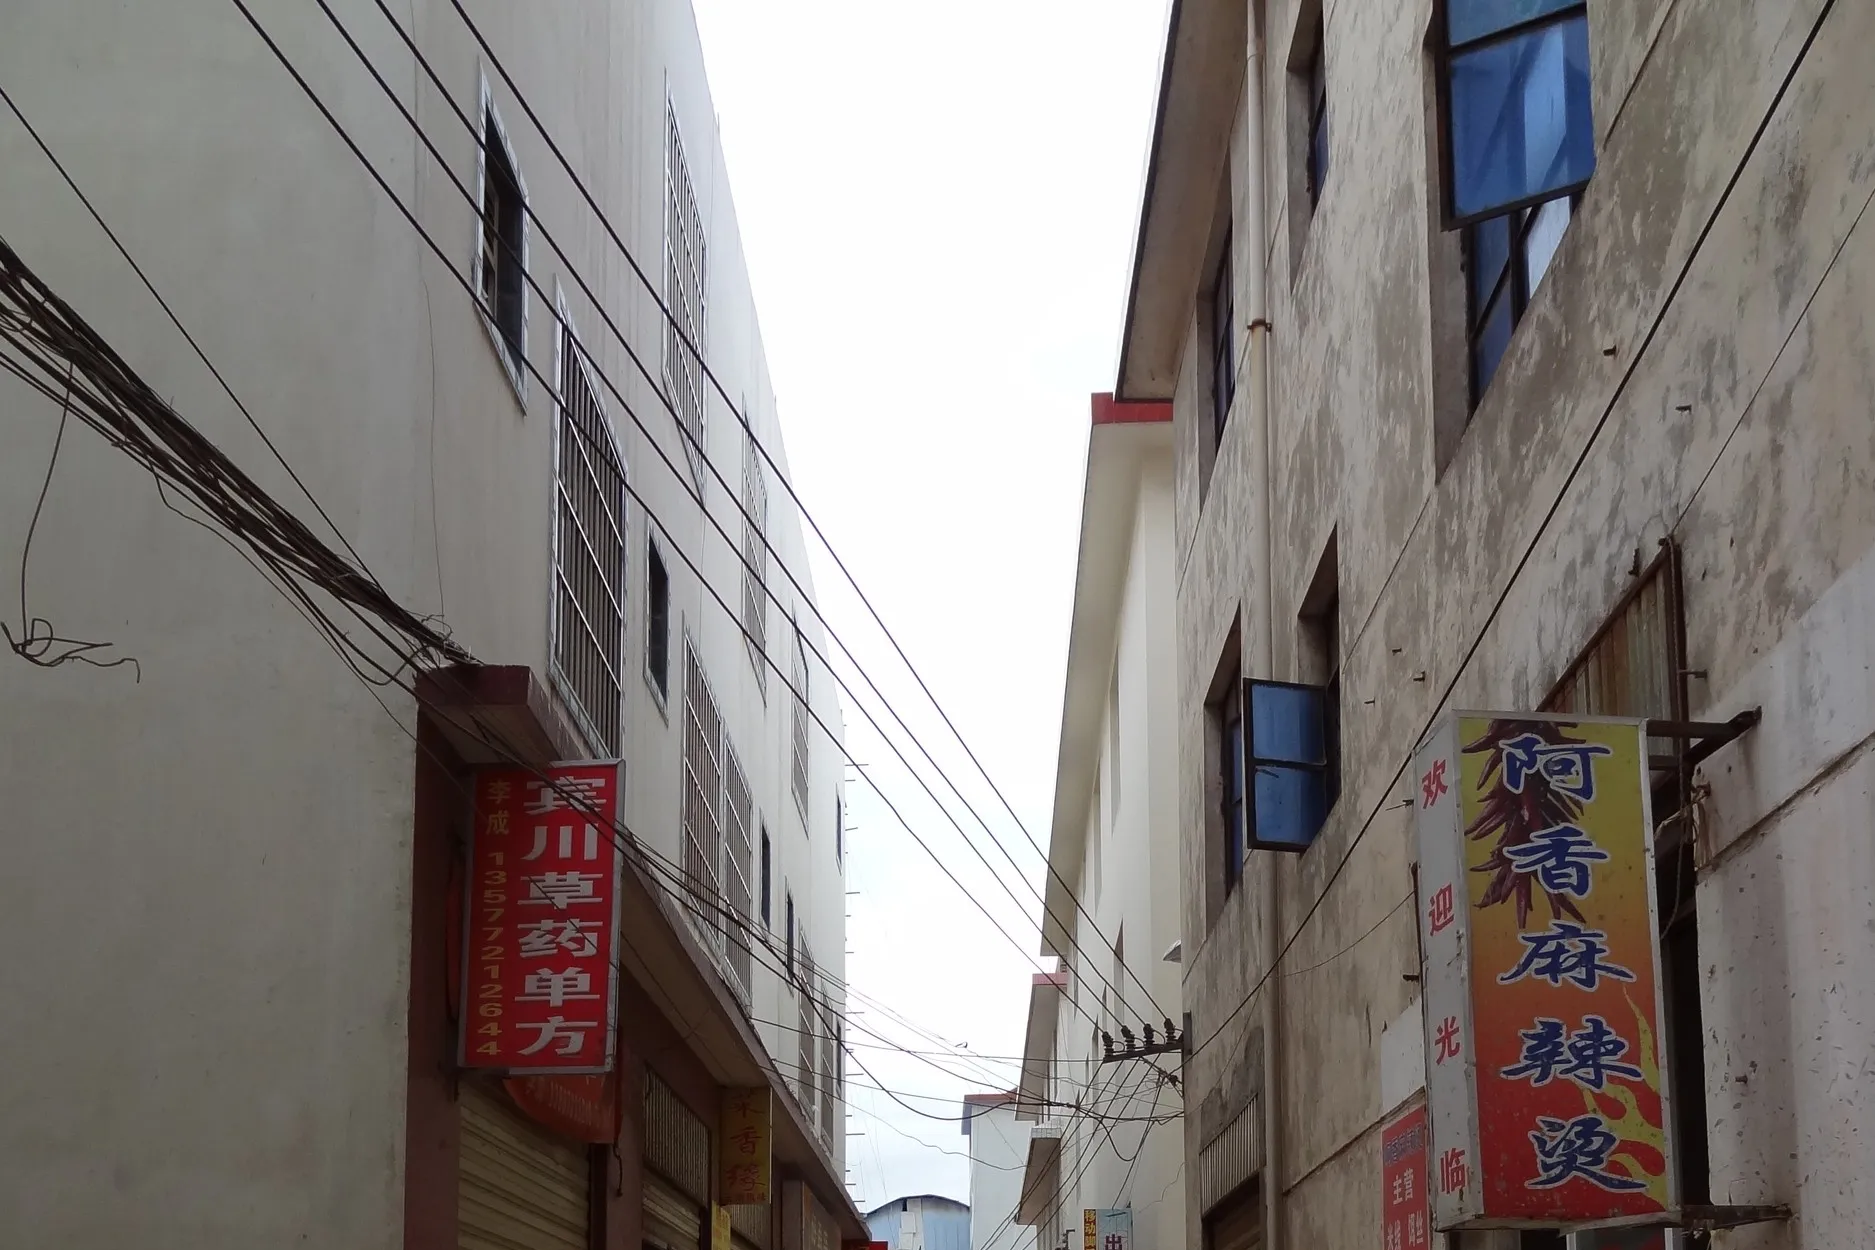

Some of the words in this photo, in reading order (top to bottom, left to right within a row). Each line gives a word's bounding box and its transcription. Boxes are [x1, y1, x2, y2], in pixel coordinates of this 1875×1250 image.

[476, 851, 508, 1057] 13577212644
[514, 775, 607, 1058] 宾川草药单方
[1420, 757, 1469, 1196] 欢迎光临
[1497, 733, 1648, 1193] 阿香麻辣烫
[1392, 1167, 1415, 1207] 主营
